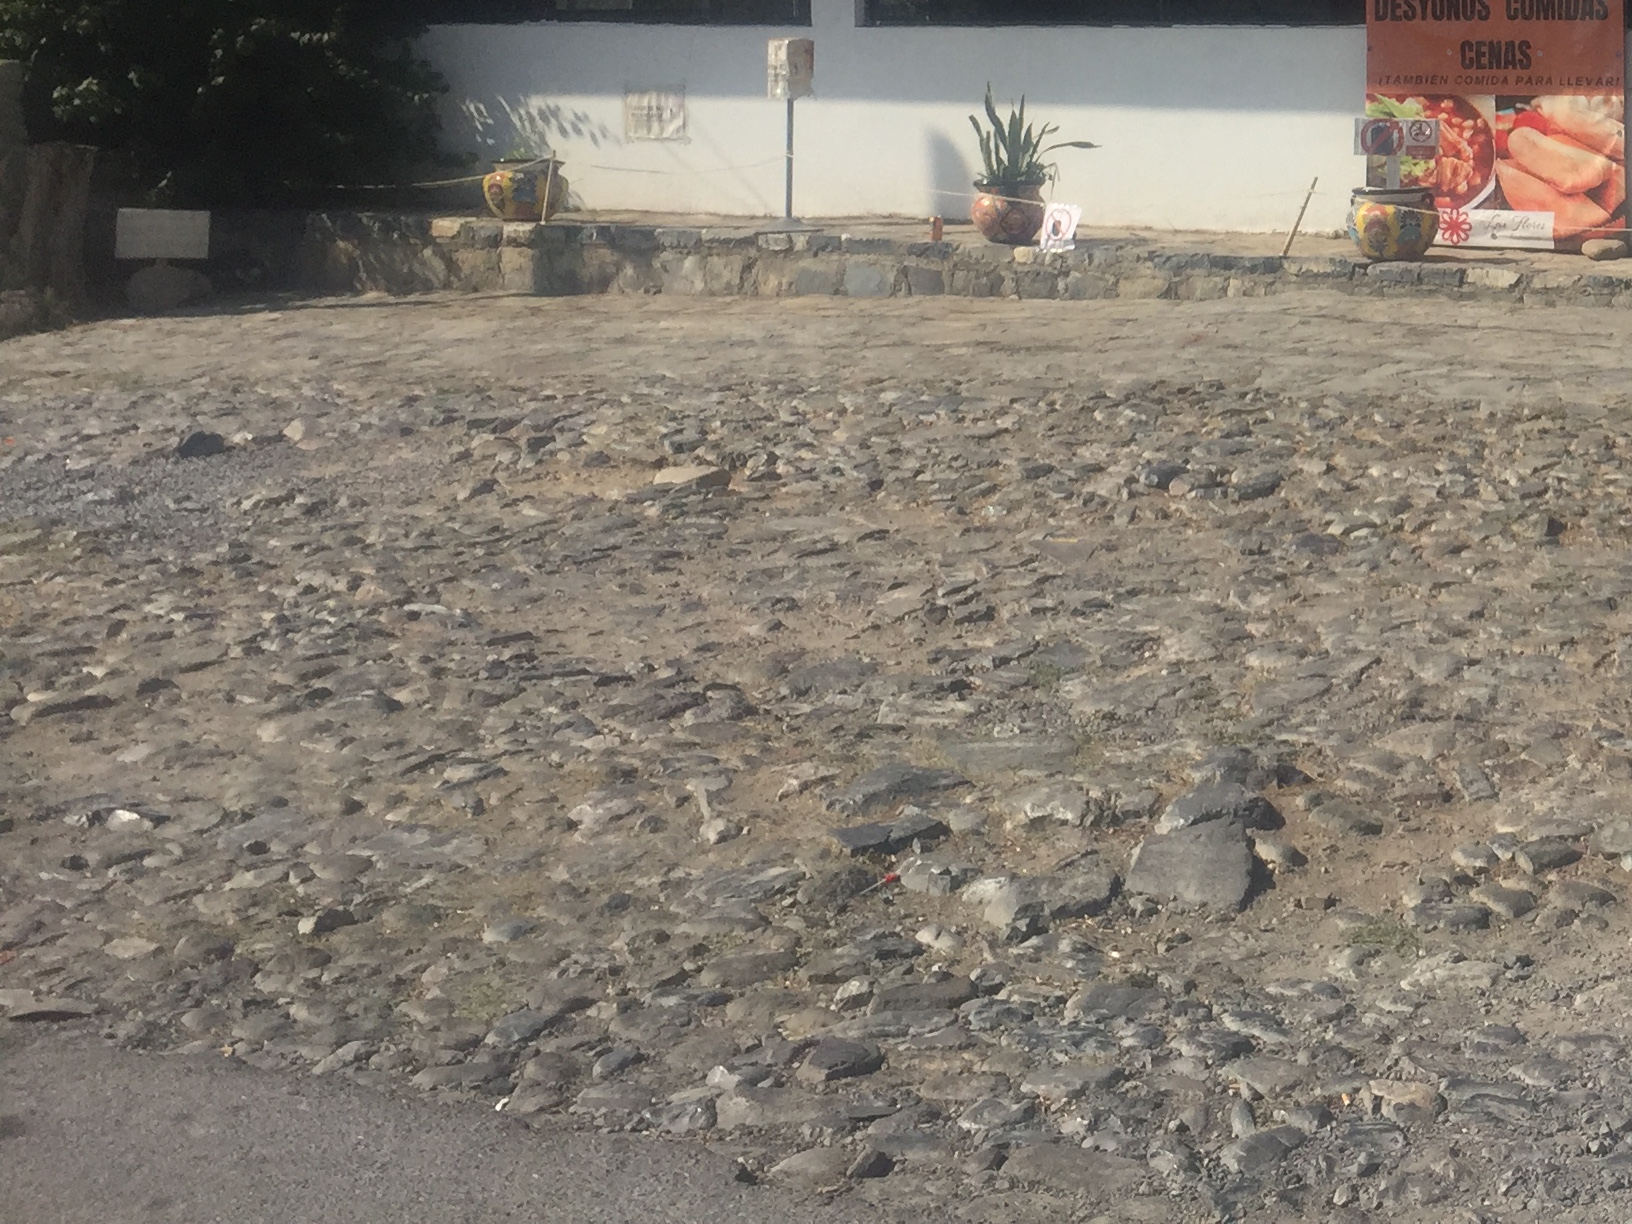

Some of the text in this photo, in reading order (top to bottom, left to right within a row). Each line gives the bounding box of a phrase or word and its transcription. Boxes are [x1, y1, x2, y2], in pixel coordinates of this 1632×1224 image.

[1459, 39, 1532, 71] CENAS
[1454, 75, 1509, 86] COMIDA
[1515, 75, 1553, 86] PARA
[1559, 75, 1621, 87] LLEVAR!
